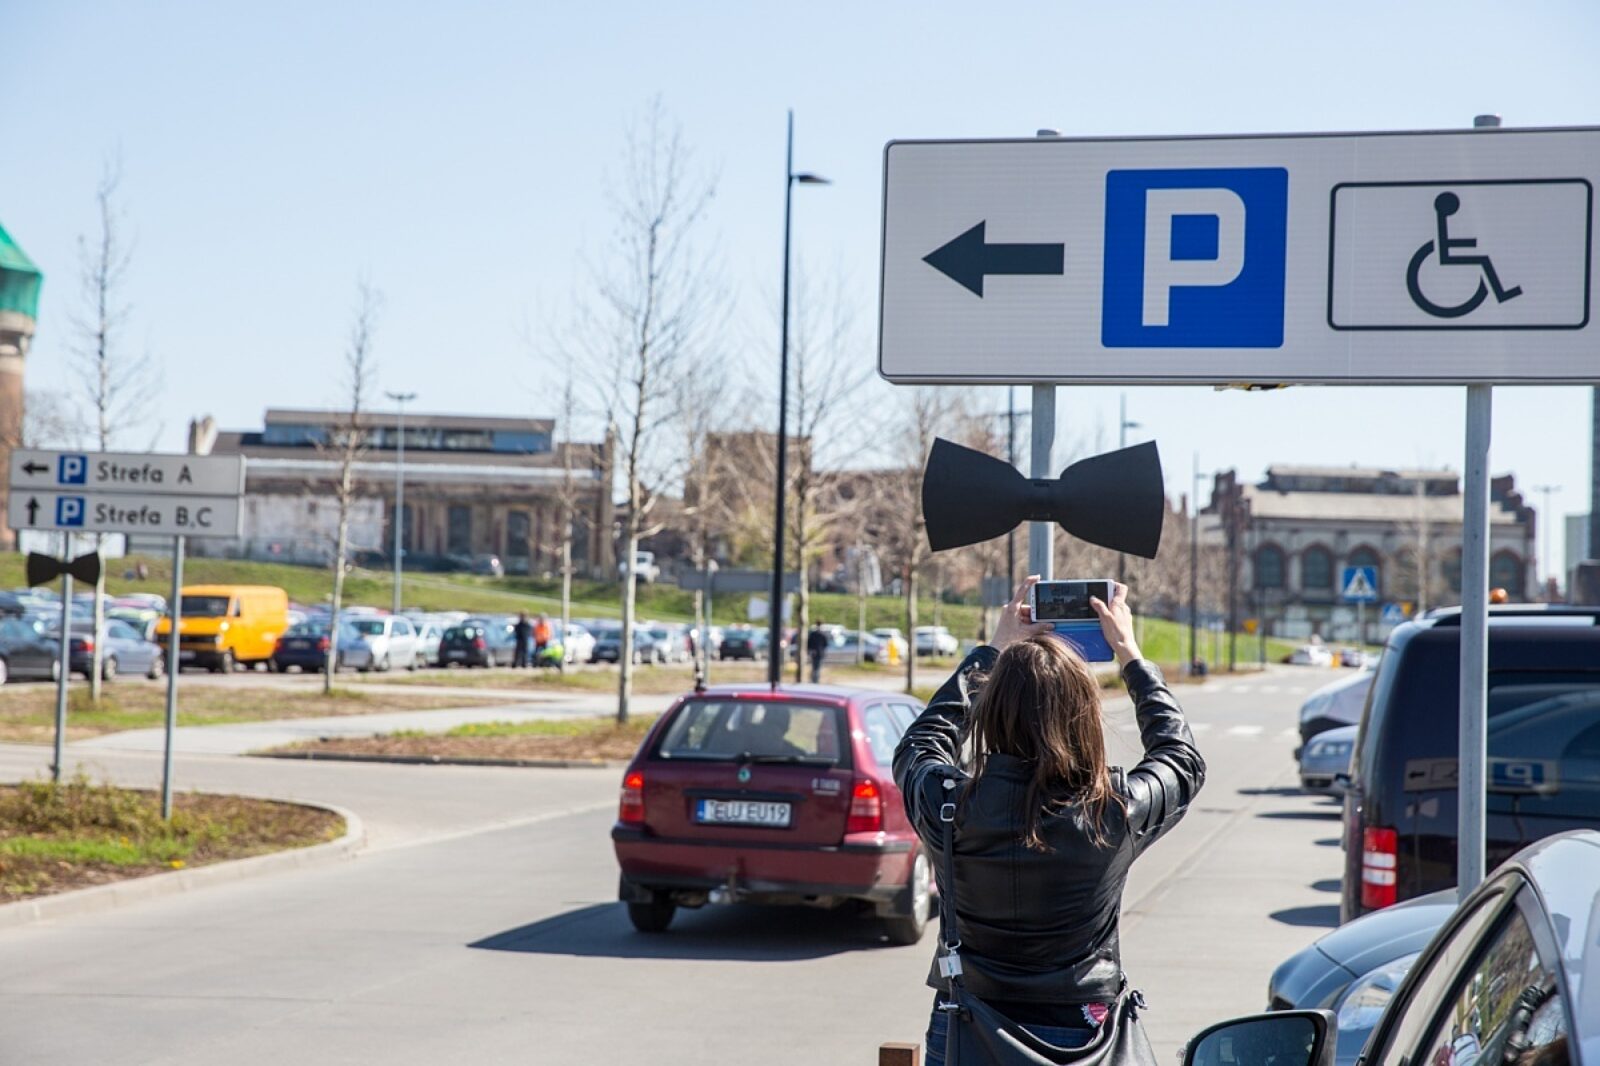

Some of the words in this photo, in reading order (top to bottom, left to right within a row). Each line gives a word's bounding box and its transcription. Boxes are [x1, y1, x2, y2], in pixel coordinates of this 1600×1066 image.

[1142, 187, 1247, 327] P
[63, 457, 83, 481] P
[96, 460, 164, 484] Strefa
[177, 465, 193, 484] A
[61, 499, 80, 524] P
[94, 502, 161, 526] Strefa
